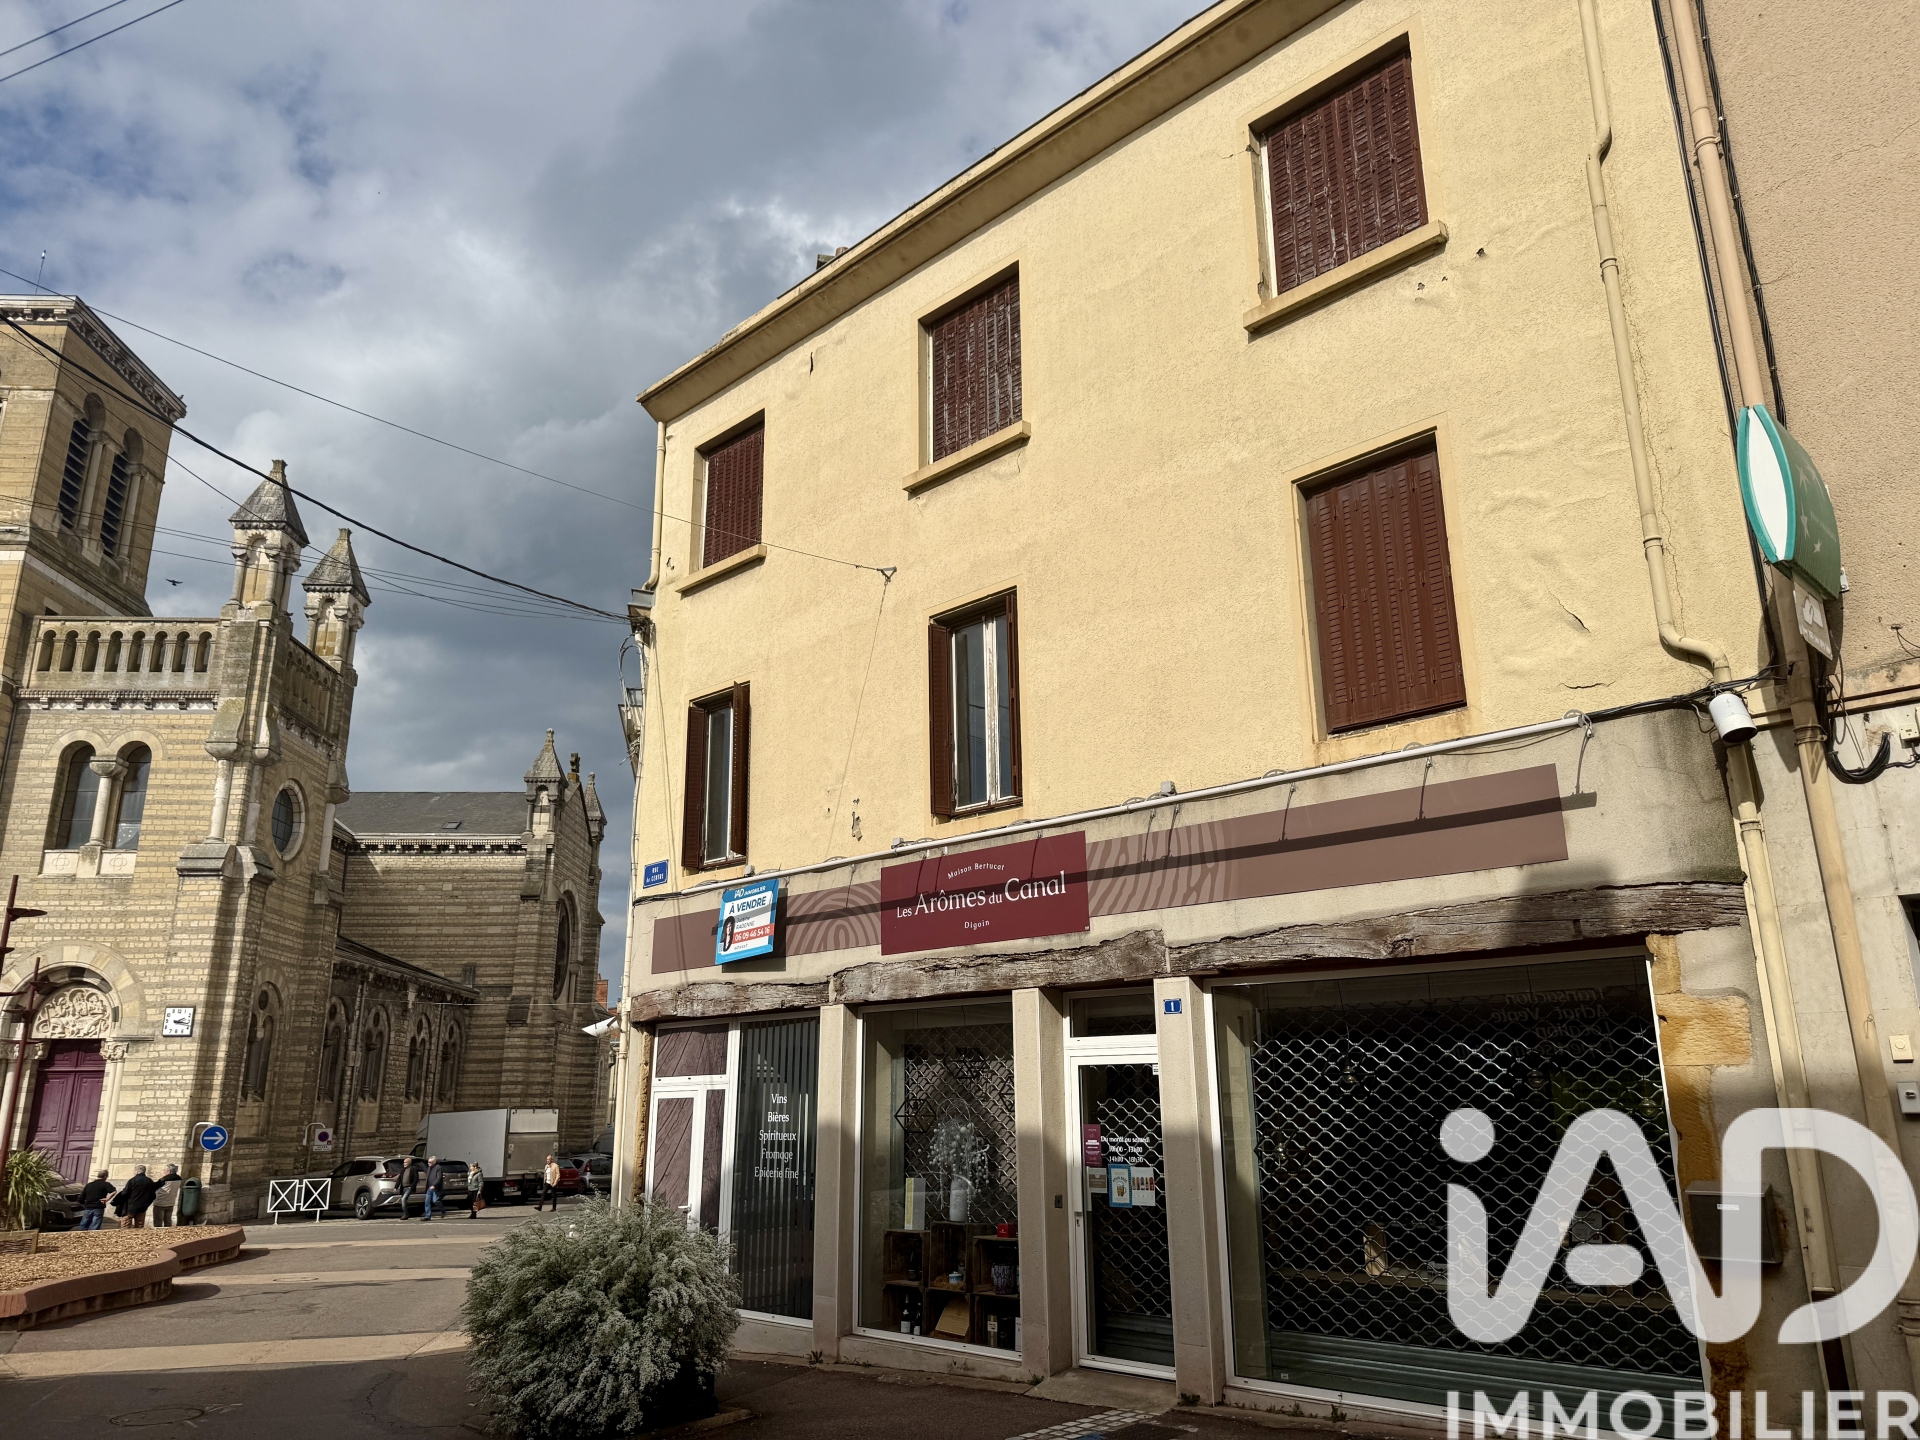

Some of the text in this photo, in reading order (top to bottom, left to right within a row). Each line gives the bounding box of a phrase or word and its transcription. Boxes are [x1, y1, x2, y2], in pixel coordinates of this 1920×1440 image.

[947, 865, 972, 880] Maison
[896, 870, 1066, 918] Les Arômes du Canal
[736, 896, 767, 912] VENDRE
[964, 920, 990, 931] Digoin
[1170, 1001, 1175, 1012] 1
[771, 1093, 788, 1104] Vins
[767, 1111, 789, 1122] Bières
[759, 1130, 797, 1144] Spiritueux
[761, 1148, 794, 1163] Fromage
[784, 1167, 799, 1179] fine
